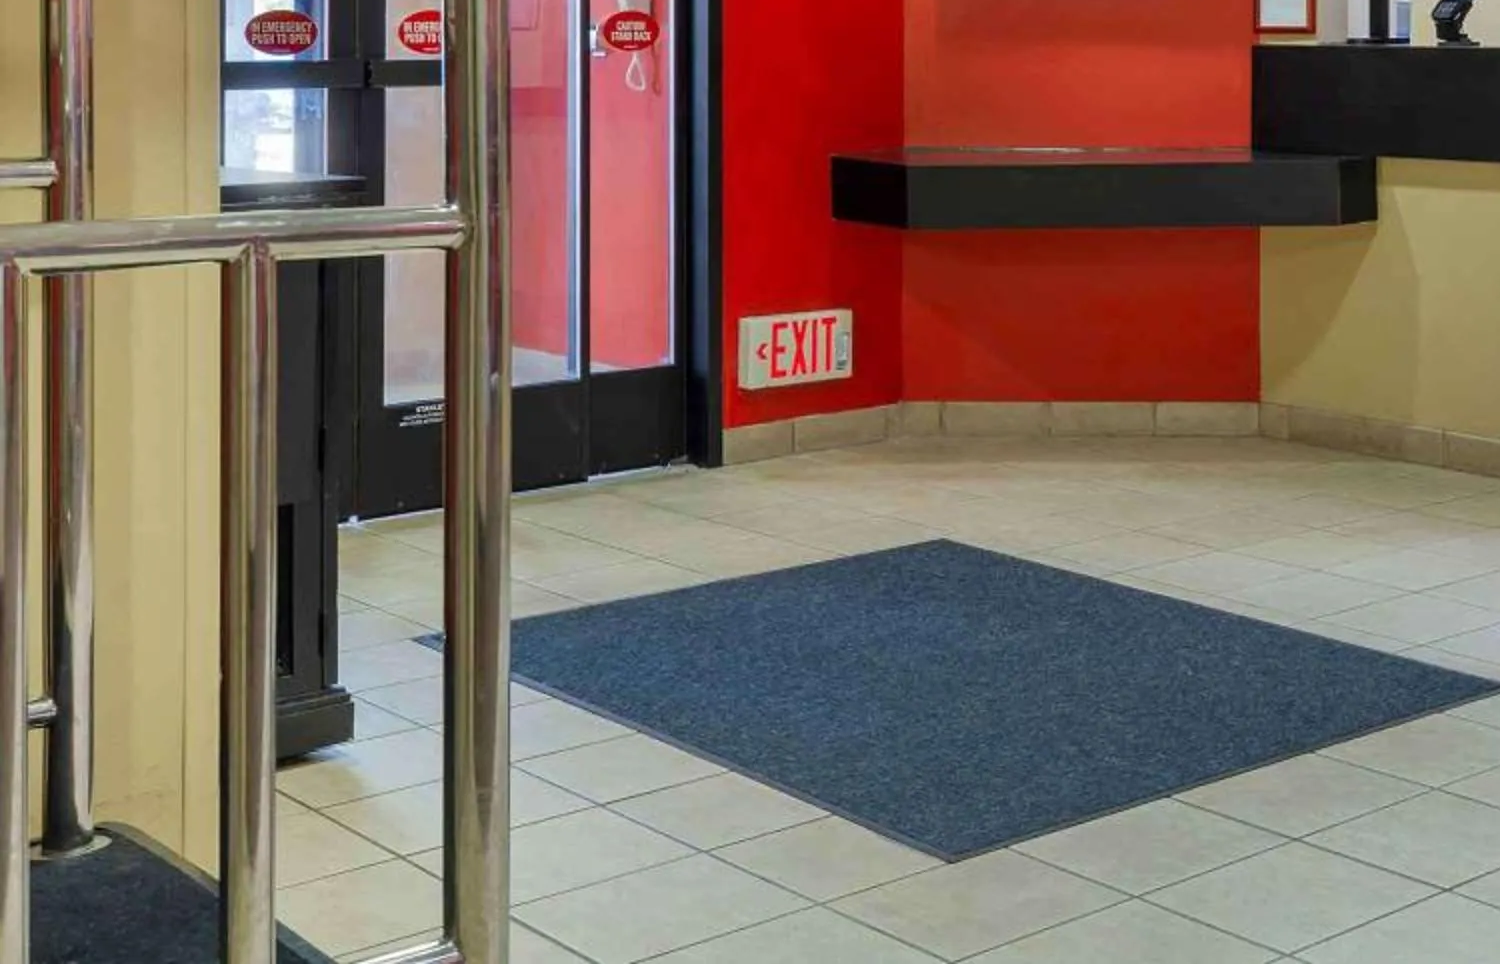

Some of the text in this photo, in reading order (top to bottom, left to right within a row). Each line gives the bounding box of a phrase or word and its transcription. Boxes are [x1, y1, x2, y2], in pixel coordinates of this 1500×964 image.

[262, 21, 312, 33] EMERGENCY
[252, 34, 311, 45] PUSH TO OPEN
[404, 34, 426, 44] PUSH
[770, 317, 837, 378] EXIT
